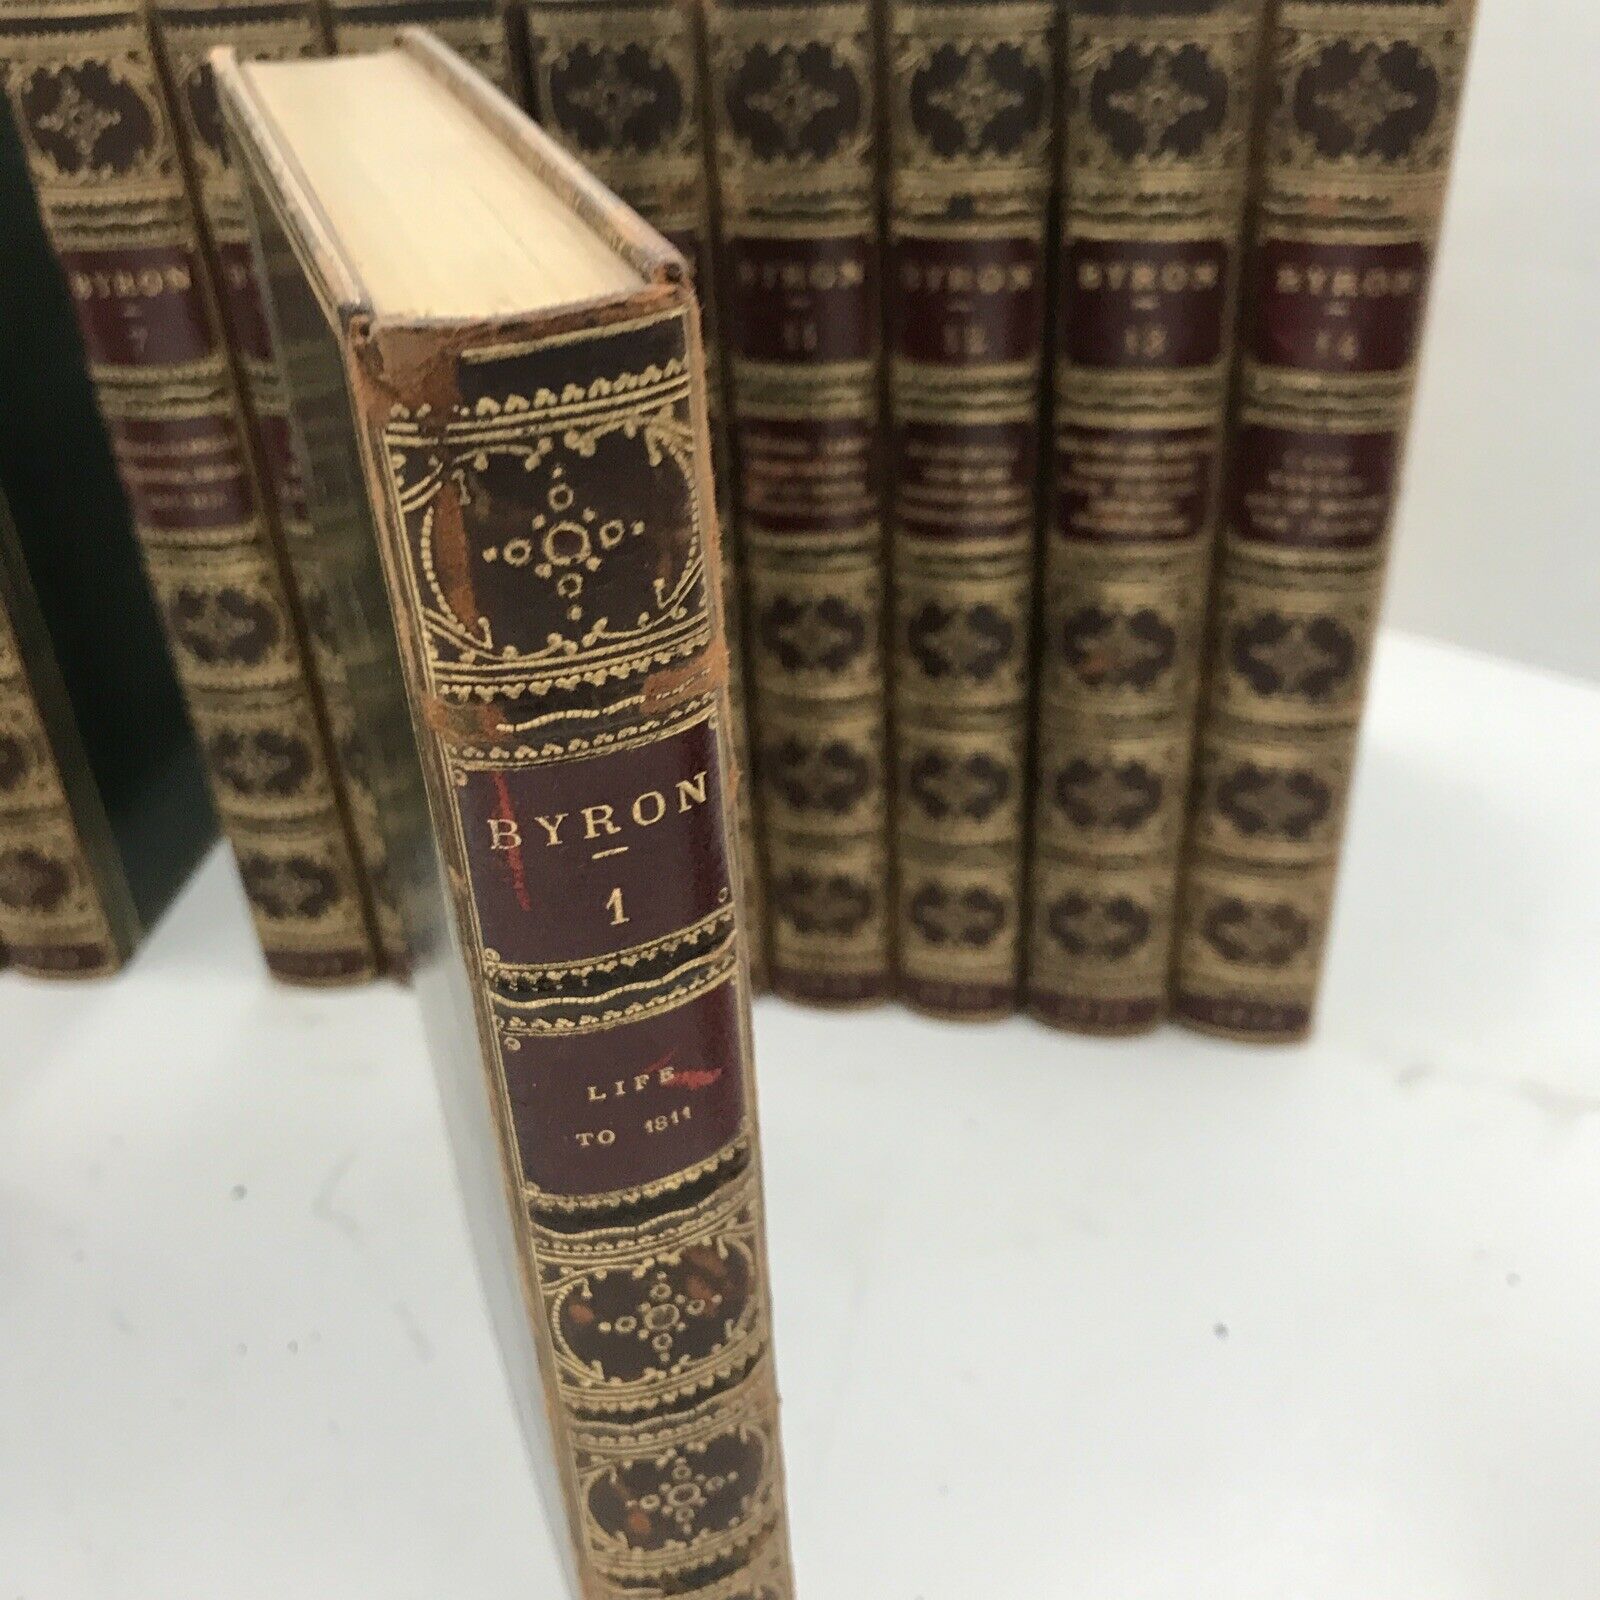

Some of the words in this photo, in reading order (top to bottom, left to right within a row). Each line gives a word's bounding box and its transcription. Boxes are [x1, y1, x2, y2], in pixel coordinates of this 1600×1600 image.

[1078, 260, 1219, 293] BYRON
[487, 771, 708, 851] BYRON
[606, 887, 630, 926] 1
[587, 1066, 675, 1101] LIFE
[575, 1129, 616, 1147] TO
[645, 1106, 692, 1133] 1811
